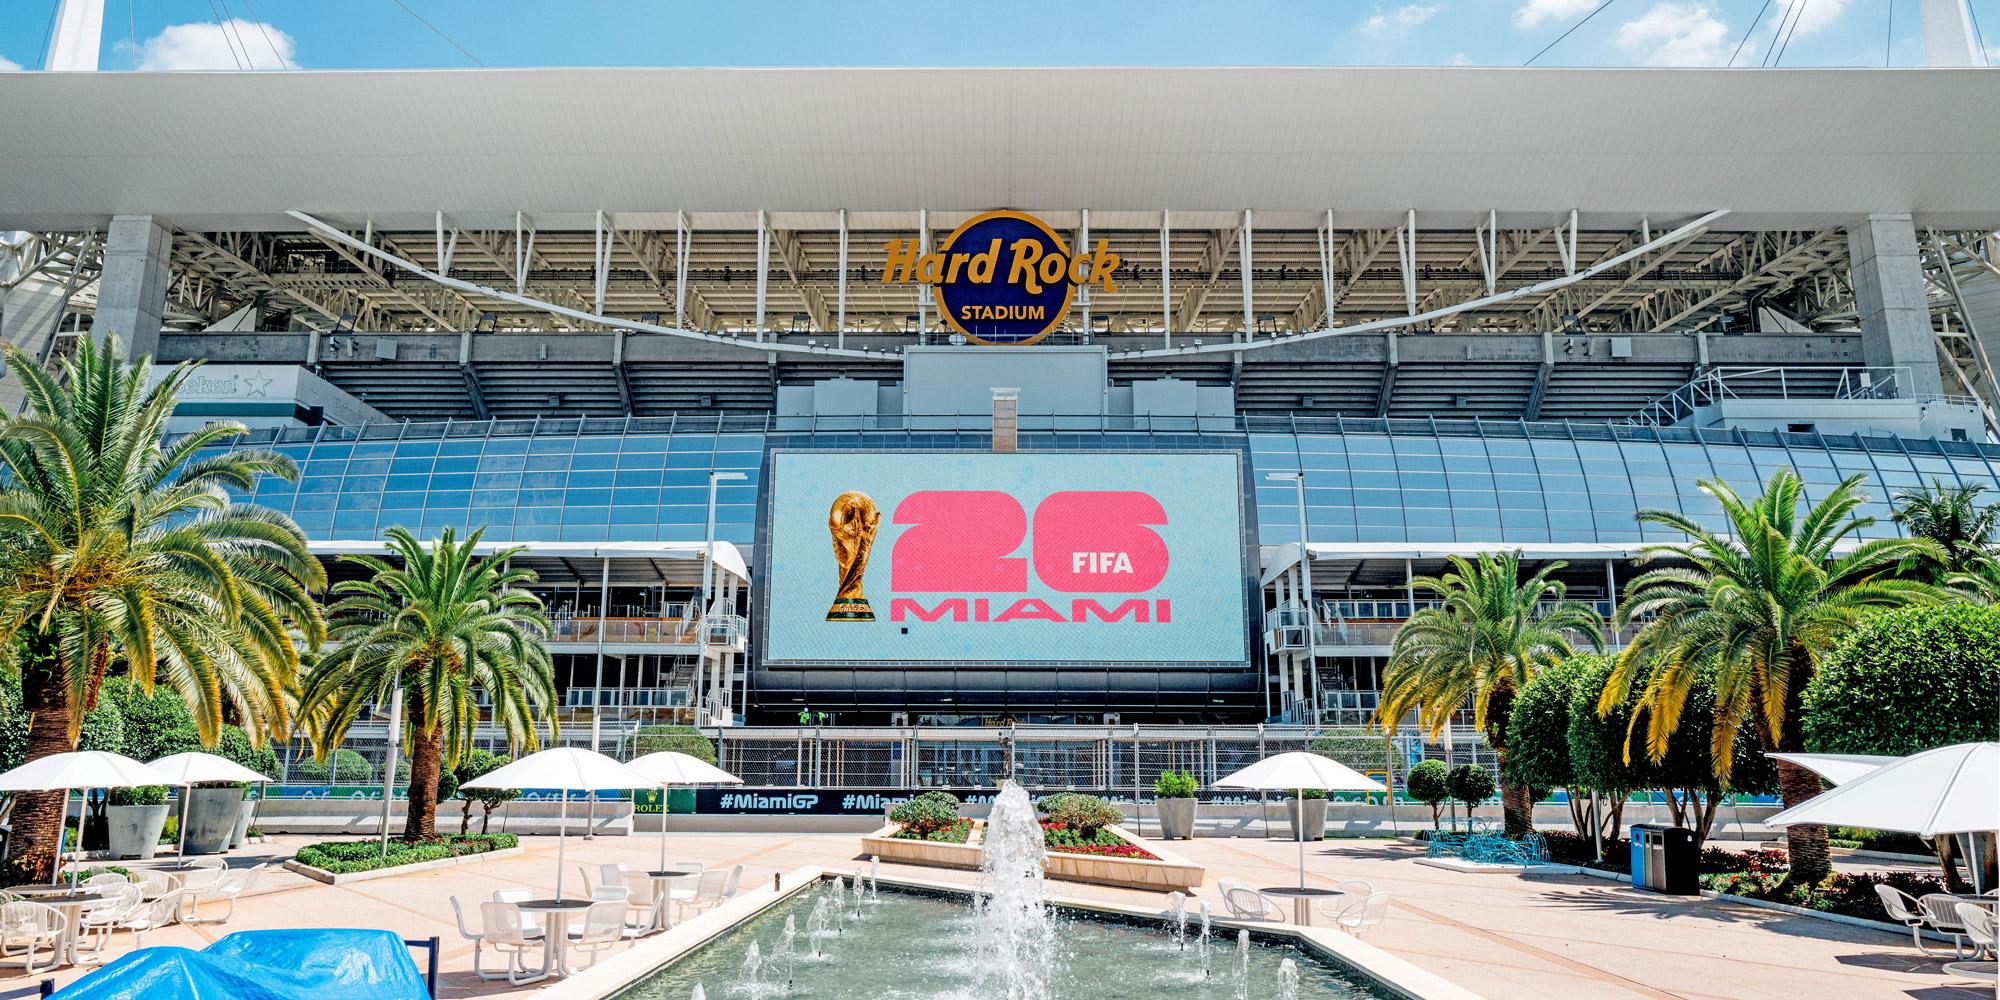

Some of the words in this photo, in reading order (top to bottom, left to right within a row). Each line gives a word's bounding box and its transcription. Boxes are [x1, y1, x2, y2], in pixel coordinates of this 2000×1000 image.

[881, 238, 1002, 285] Hard
[1007, 238, 1121, 294] Rock
[961, 305, 1045, 320] STADIUM
[891, 490, 1169, 593] 26
[1072, 552, 1134, 573] FIFA
[890, 598, 1171, 623] MIAMI
[720, 793, 819, 809] #MiamiGP
